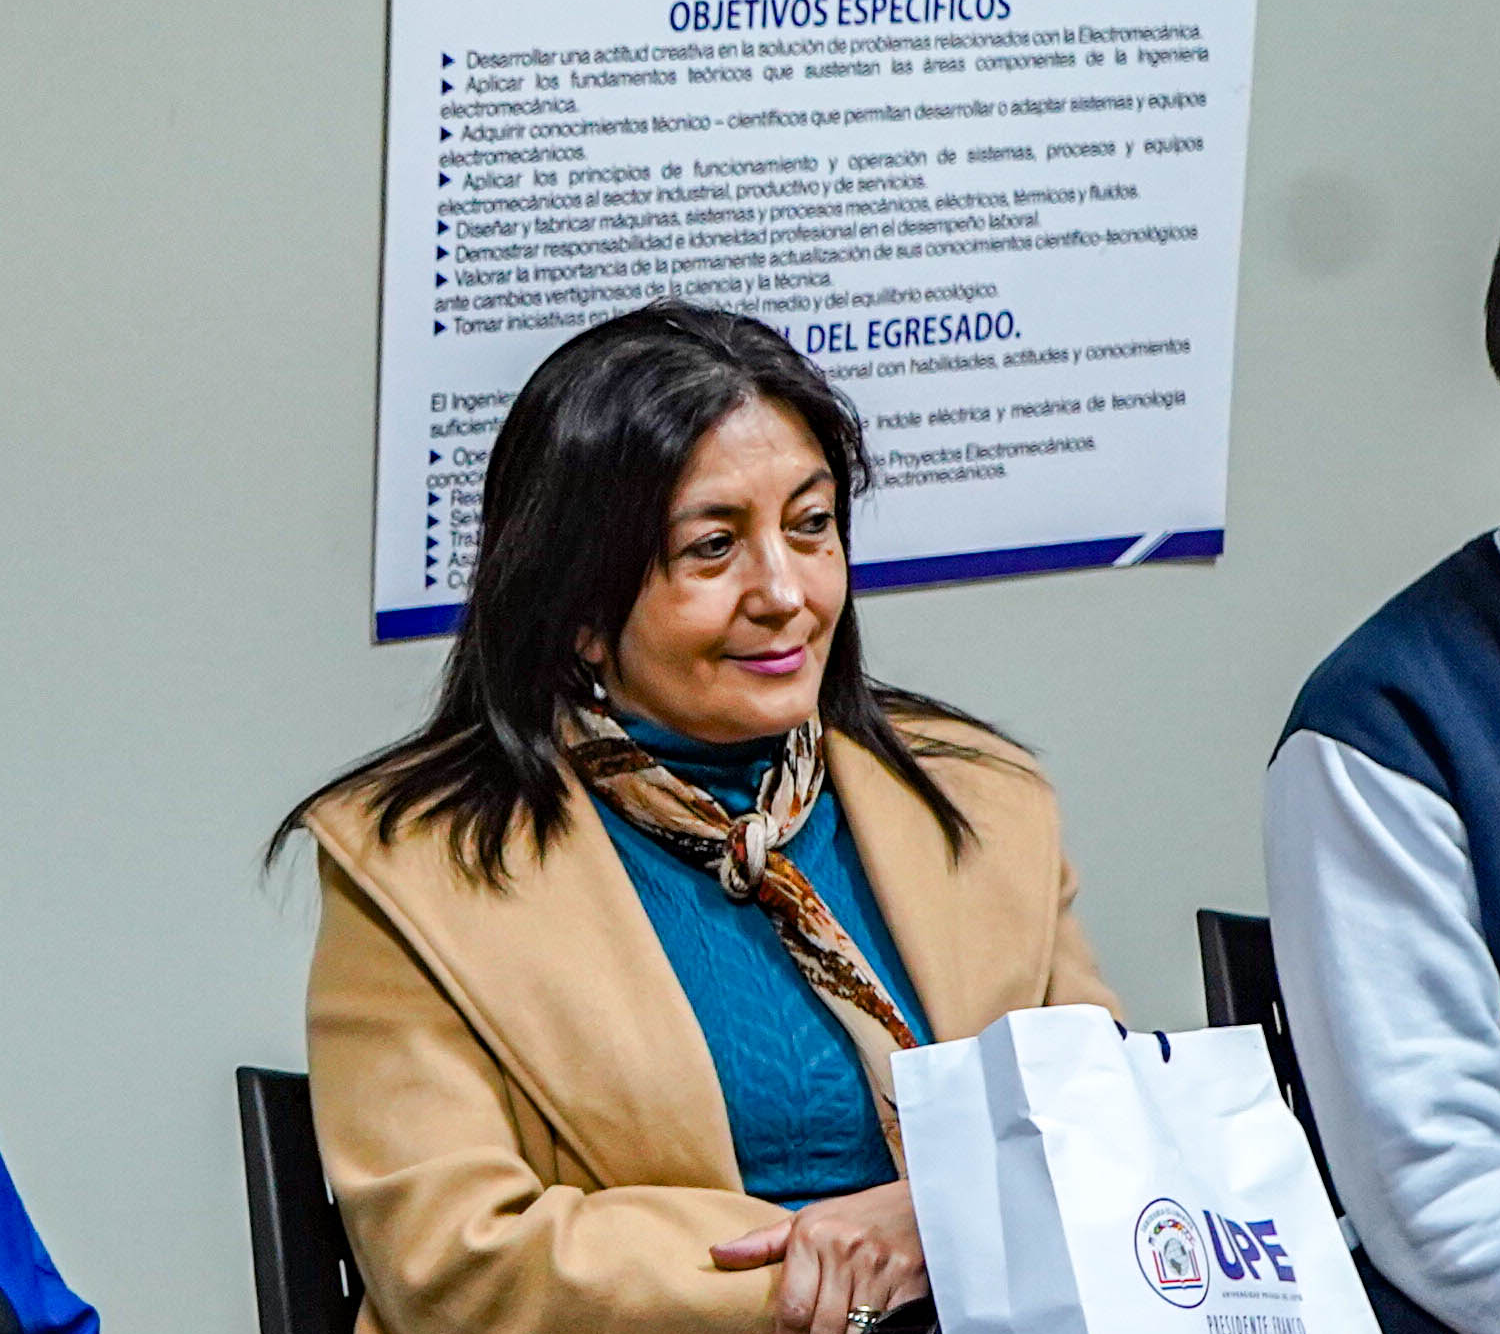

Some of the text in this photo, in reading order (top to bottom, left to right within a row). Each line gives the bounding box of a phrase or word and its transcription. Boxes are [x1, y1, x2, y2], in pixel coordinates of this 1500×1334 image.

[807, 323, 858, 354] DEL
[868, 310, 1020, 350] EGRESADO.
[1202, 1209, 1297, 1283] UPE
